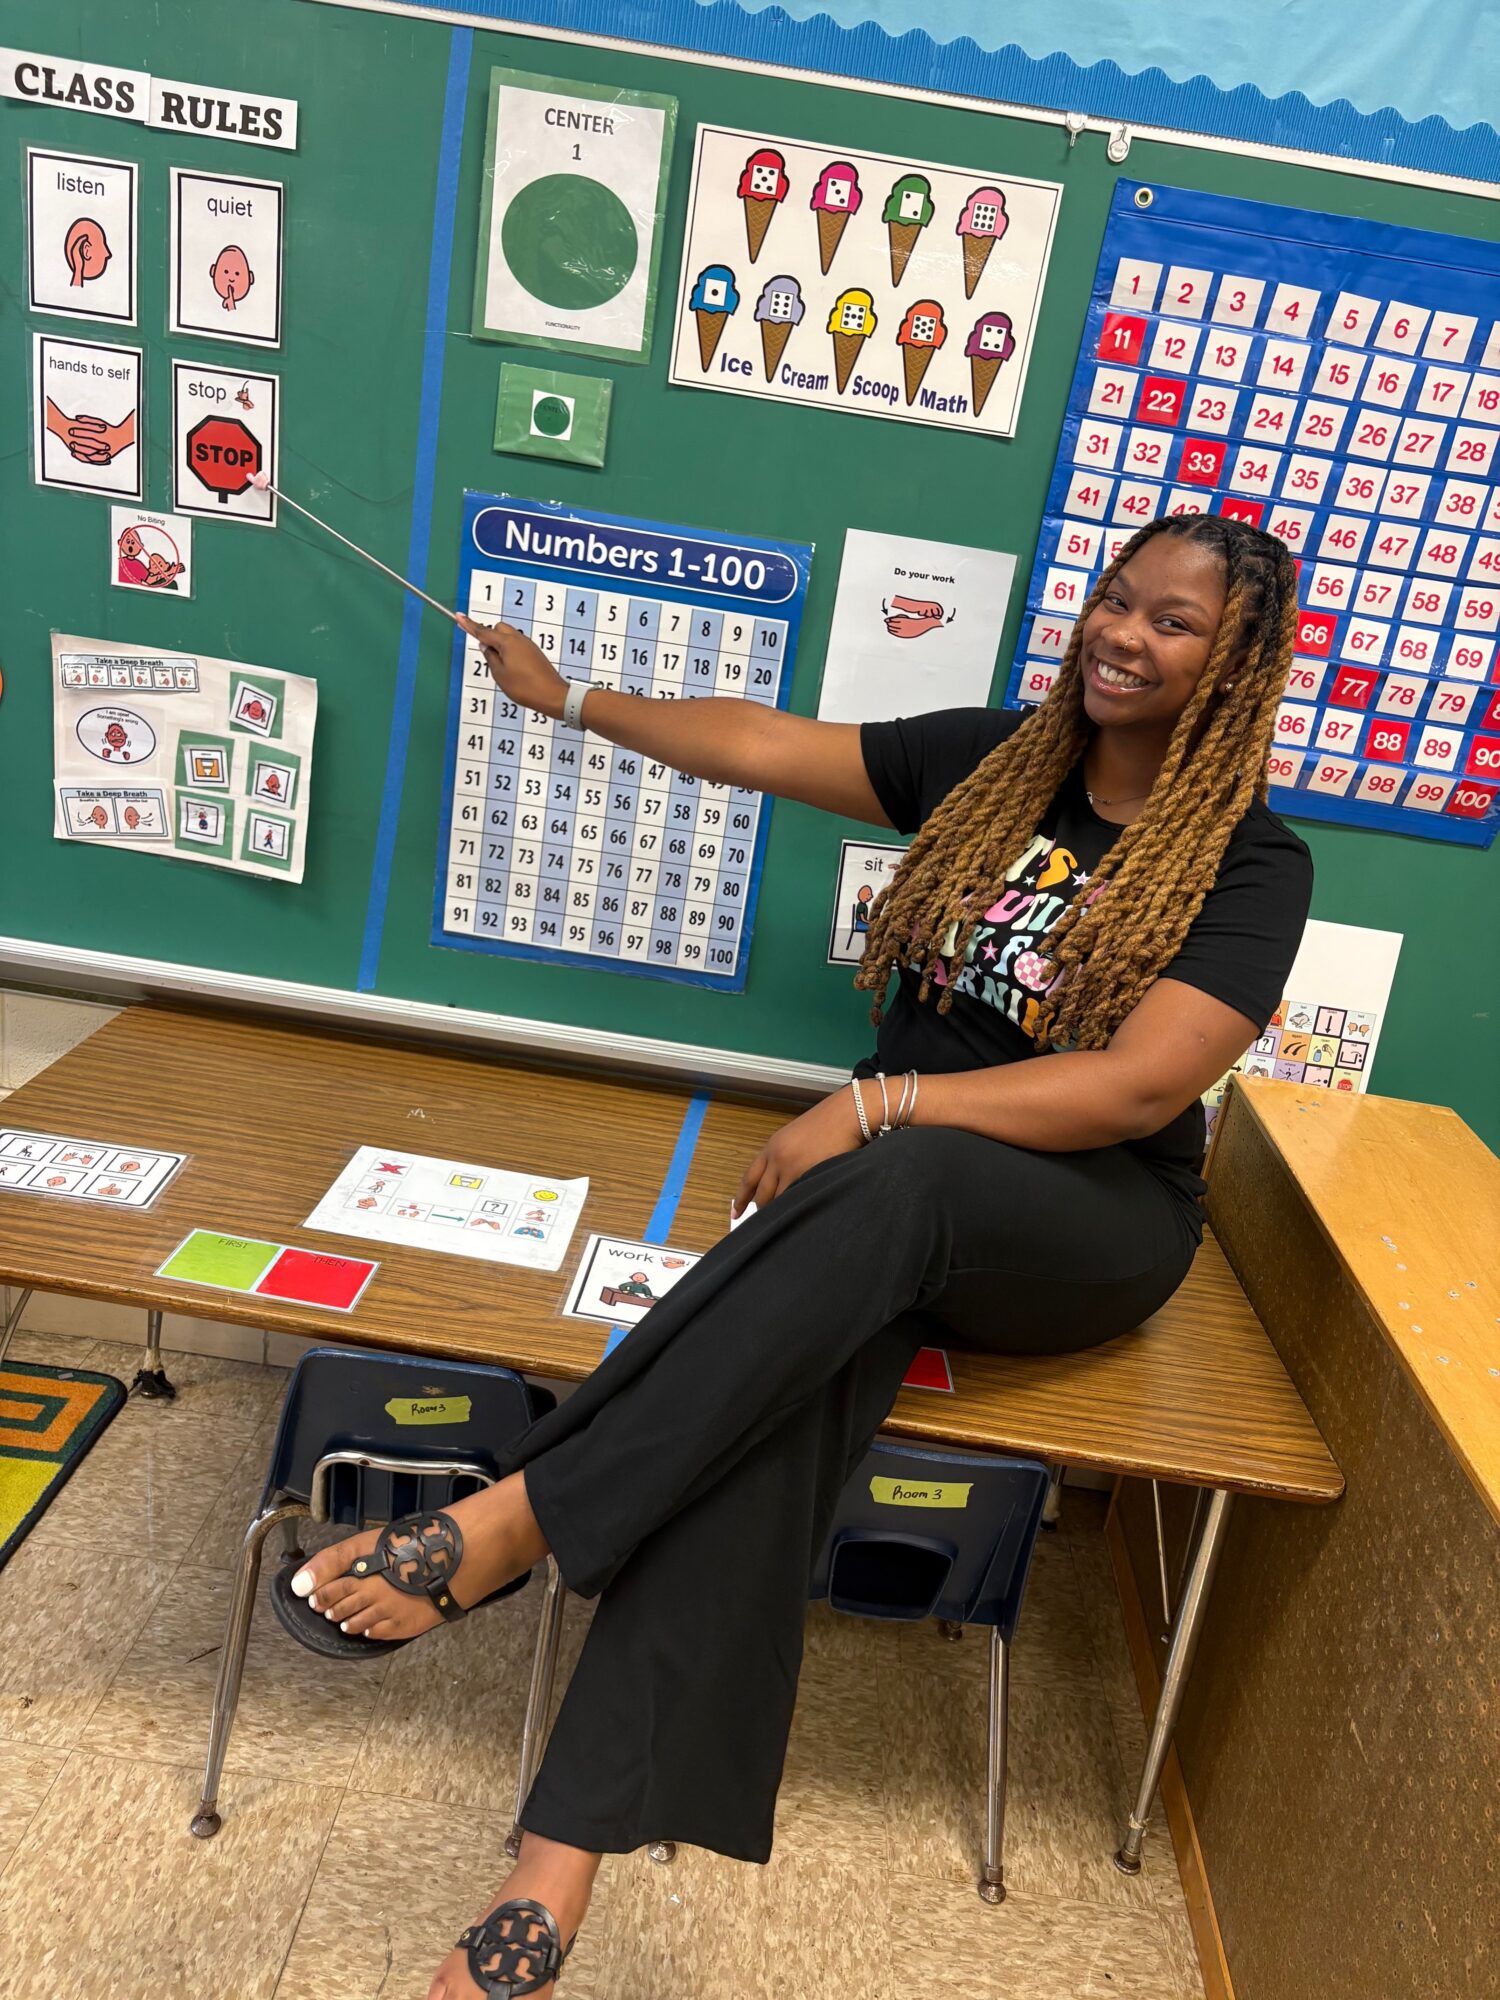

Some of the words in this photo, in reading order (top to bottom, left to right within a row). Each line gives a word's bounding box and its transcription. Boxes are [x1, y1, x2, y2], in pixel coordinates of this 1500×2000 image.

[14, 63, 136, 114] CLASS
[161, 91, 283, 141] RULES
[544, 107, 614, 135] CENTER
[572, 143, 582, 161] 1
[56, 172, 105, 197] listen
[207, 196, 253, 219] quiet
[1132, 275, 1140, 296] 1
[1177, 282, 1194, 305] 2
[1229, 290, 1246, 313] 3
[1283, 301, 1300, 321] 4
[1343, 309, 1359, 331] 5
[1393, 318, 1410, 339] 6
[1442, 327, 1459, 347] 7
[49, 357, 89, 378] hands
[91, 363, 104, 377] to
[107, 366, 131, 381] self
[720, 353, 752, 376] Ice
[781, 363, 829, 390] Cream
[852, 375, 899, 405] Scoop
[919, 388, 967, 413] Math
[1114, 328, 1131, 349] 11
[1164, 337, 1186, 360] 12
[1216, 345, 1237, 367] 13
[1273, 355, 1294, 376] 14
[1329, 363, 1350, 385] 15
[1377, 372, 1400, 394] 16
[1432, 382, 1455, 403] 17
[188, 381, 227, 403] stop
[1101, 383, 1124, 404] 21
[1147, 390, 1176, 413] 22
[1196, 398, 1227, 422] 23
[1253, 408, 1284, 431] 24
[1304, 414, 1333, 437] 25
[1358, 423, 1388, 447] 26
[1403, 432, 1435, 453] 27
[1456, 440, 1487, 463] 28
[195, 443, 254, 469] STOP
[137, 514, 147, 522] No
[147, 516, 166, 526] Biting
[1076, 486, 1100, 507] 41
[1122, 495, 1151, 516] 42
[1273, 519, 1301, 541] 45
[1328, 529, 1358, 549] 46
[1379, 536, 1409, 556] 47
[1427, 543, 1457, 564] 48
[505, 520, 659, 574] Numbers
[667, 547, 766, 590] 1-100
[894, 567, 906, 577] Do
[908, 571, 930, 580] your
[932, 574, 955, 584] work
[1067, 534, 1090, 556] 51
[1316, 576, 1344, 597] 56
[1363, 584, 1392, 604] 57
[1411, 591, 1441, 613] 58
[1464, 599, 1494, 620] 59
[486, 585, 491, 601] 1
[515, 589, 523, 606] 2
[546, 595, 554, 611] 3
[576, 601, 585, 616] 4
[608, 606, 617, 621] 5
[639, 611, 648, 627] 6
[672, 616, 680, 631] 7
[701, 621, 711, 637] 8
[734, 626, 742, 641] 9
[761, 630, 777, 648] 10
[1053, 581, 1075, 601] 61
[1301, 624, 1328, 644] 66
[1351, 631, 1379, 651] 67
[1399, 639, 1428, 660] 68
[1455, 648, 1483, 669] 69
[539, 633, 554, 650] 13
[569, 639, 585, 656] 14
[601, 644, 617, 660] 15
[632, 648, 647, 666] 16
[663, 654, 679, 670] 17
[694, 658, 710, 675] 18
[725, 664, 741, 680] 19
[754, 668, 772, 685] 20
[471, 698, 486, 714] 31
[500, 702, 518, 719] 32
[468, 735, 483, 750] 41
[497, 739, 514, 755] 42
[528, 744, 544, 760] 43
[558, 749, 575, 765] 44
[588, 754, 605, 770] 45
[618, 759, 635, 775] 46
[648, 764, 666, 779] 47
[1278, 715, 1306, 734] 86
[1324, 721, 1353, 741] 87
[1374, 732, 1402, 751] 88
[1424, 739, 1451, 758] 89
[103, 790, 121, 798] Deep
[465, 770, 480, 786] 51
[494, 774, 511, 791] 52
[525, 779, 540, 795] 53
[554, 784, 571, 800] 54
[585, 789, 601, 805] 55
[614, 794, 631, 810] 56
[644, 799, 661, 815] 57
[673, 804, 690, 820] 58
[703, 809, 720, 824] 59
[733, 814, 750, 829] 60
[1320, 767, 1348, 784] 97
[1368, 776, 1396, 793] 98
[1415, 783, 1444, 801] 99
[1455, 788, 1490, 809] 100
[460, 840, 474, 855] 71
[489, 844, 504, 860] 72
[519, 849, 534, 864] 73
[548, 853, 564, 869] 74
[578, 858, 593, 873] 75
[607, 863, 622, 878] 76
[636, 868, 652, 883] 77
[665, 872, 681, 888] 78
[695, 877, 710, 892] 79
[723, 881, 740, 897] 80
[863, 857, 883, 873] sit
[454, 907, 468, 922] 91
[482, 912, 498, 927] 92
[512, 917, 526, 931] 93
[540, 921, 556, 936] 94
[570, 926, 585, 941] 95
[598, 930, 614, 946] 96
[627, 935, 643, 950] 97
[656, 939, 672, 955] 98
[685, 944, 700, 959] 99
[710, 948, 733, 964] 100
[218, 1238, 250, 1249] FIRST
[608, 1246, 654, 1264] work
[411, 1403, 437, 1416] Room
[438, 1404, 447, 1413] 3
[892, 1485, 928, 1500] Room
[932, 1489, 943, 1500] 3
